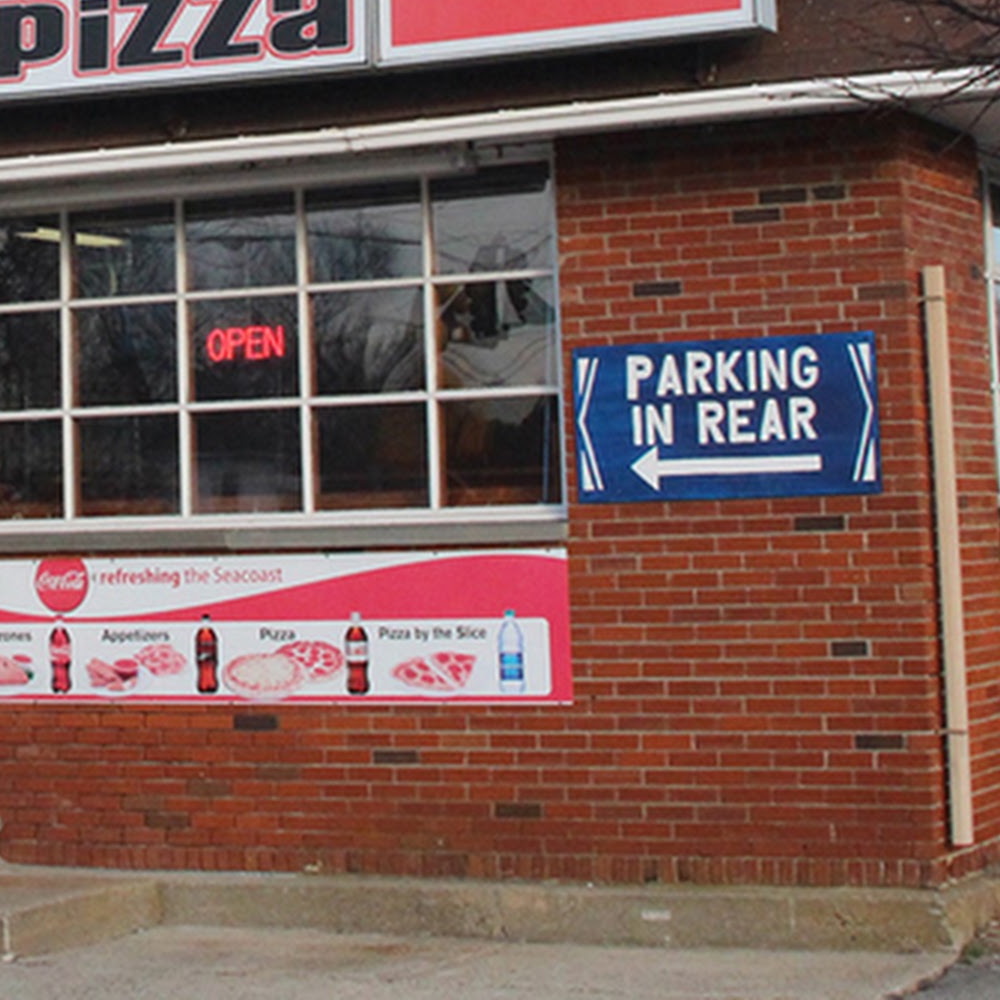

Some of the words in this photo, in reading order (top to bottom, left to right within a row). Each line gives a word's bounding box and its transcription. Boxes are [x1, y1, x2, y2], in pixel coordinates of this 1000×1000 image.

[206, 325, 285, 362] OPEN
[626, 346, 820, 401] PARKING
[632, 402, 674, 446] IN
[697, 397, 818, 446] REAR
[99, 567, 181, 588] refreshing
[184, 567, 210, 584] the
[214, 565, 283, 584] Seacoast
[101, 628, 170, 645] Appetizers
[259, 627, 296, 641] Pizza
[378, 626, 411, 640] Pizza
[414, 626, 430, 642] by
[433, 626, 452, 640] the
[456, 625, 487, 639] Slice
